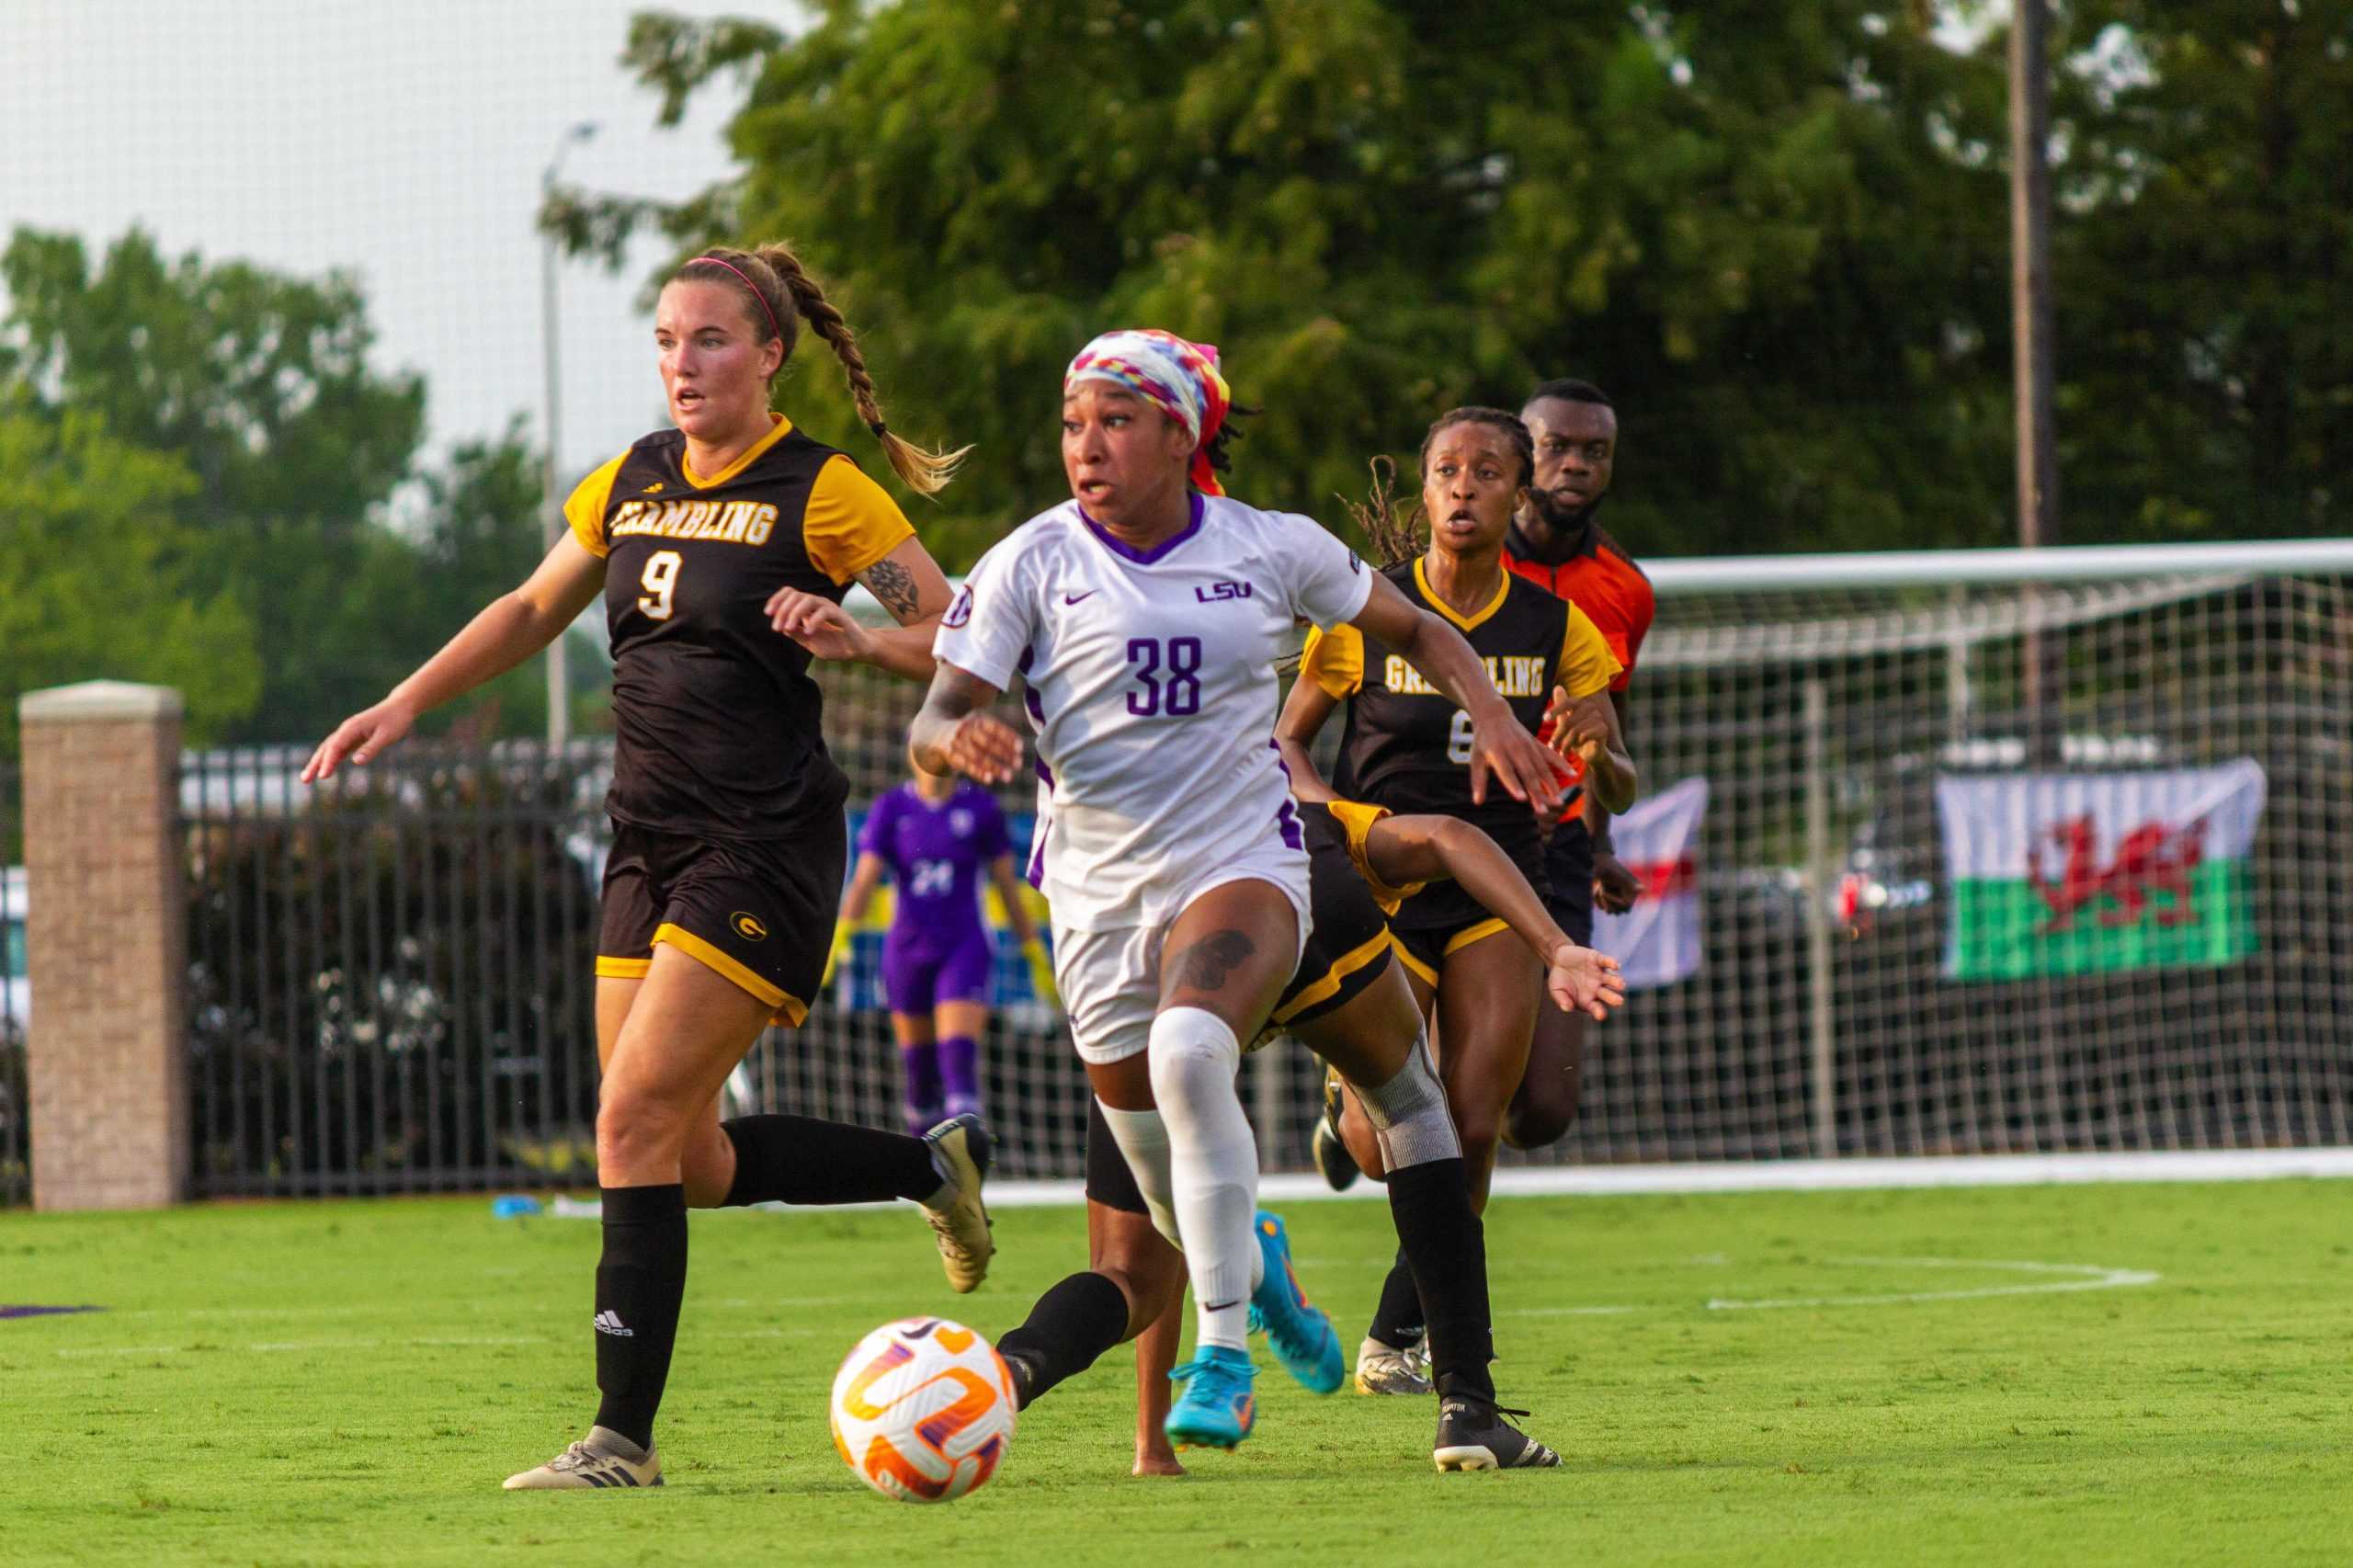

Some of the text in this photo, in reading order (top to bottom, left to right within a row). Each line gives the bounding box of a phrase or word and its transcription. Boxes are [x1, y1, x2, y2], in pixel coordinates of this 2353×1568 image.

[638, 550, 683, 620] 9
[1194, 580, 1252, 603] LSU
[1127, 636, 1201, 716] 38
